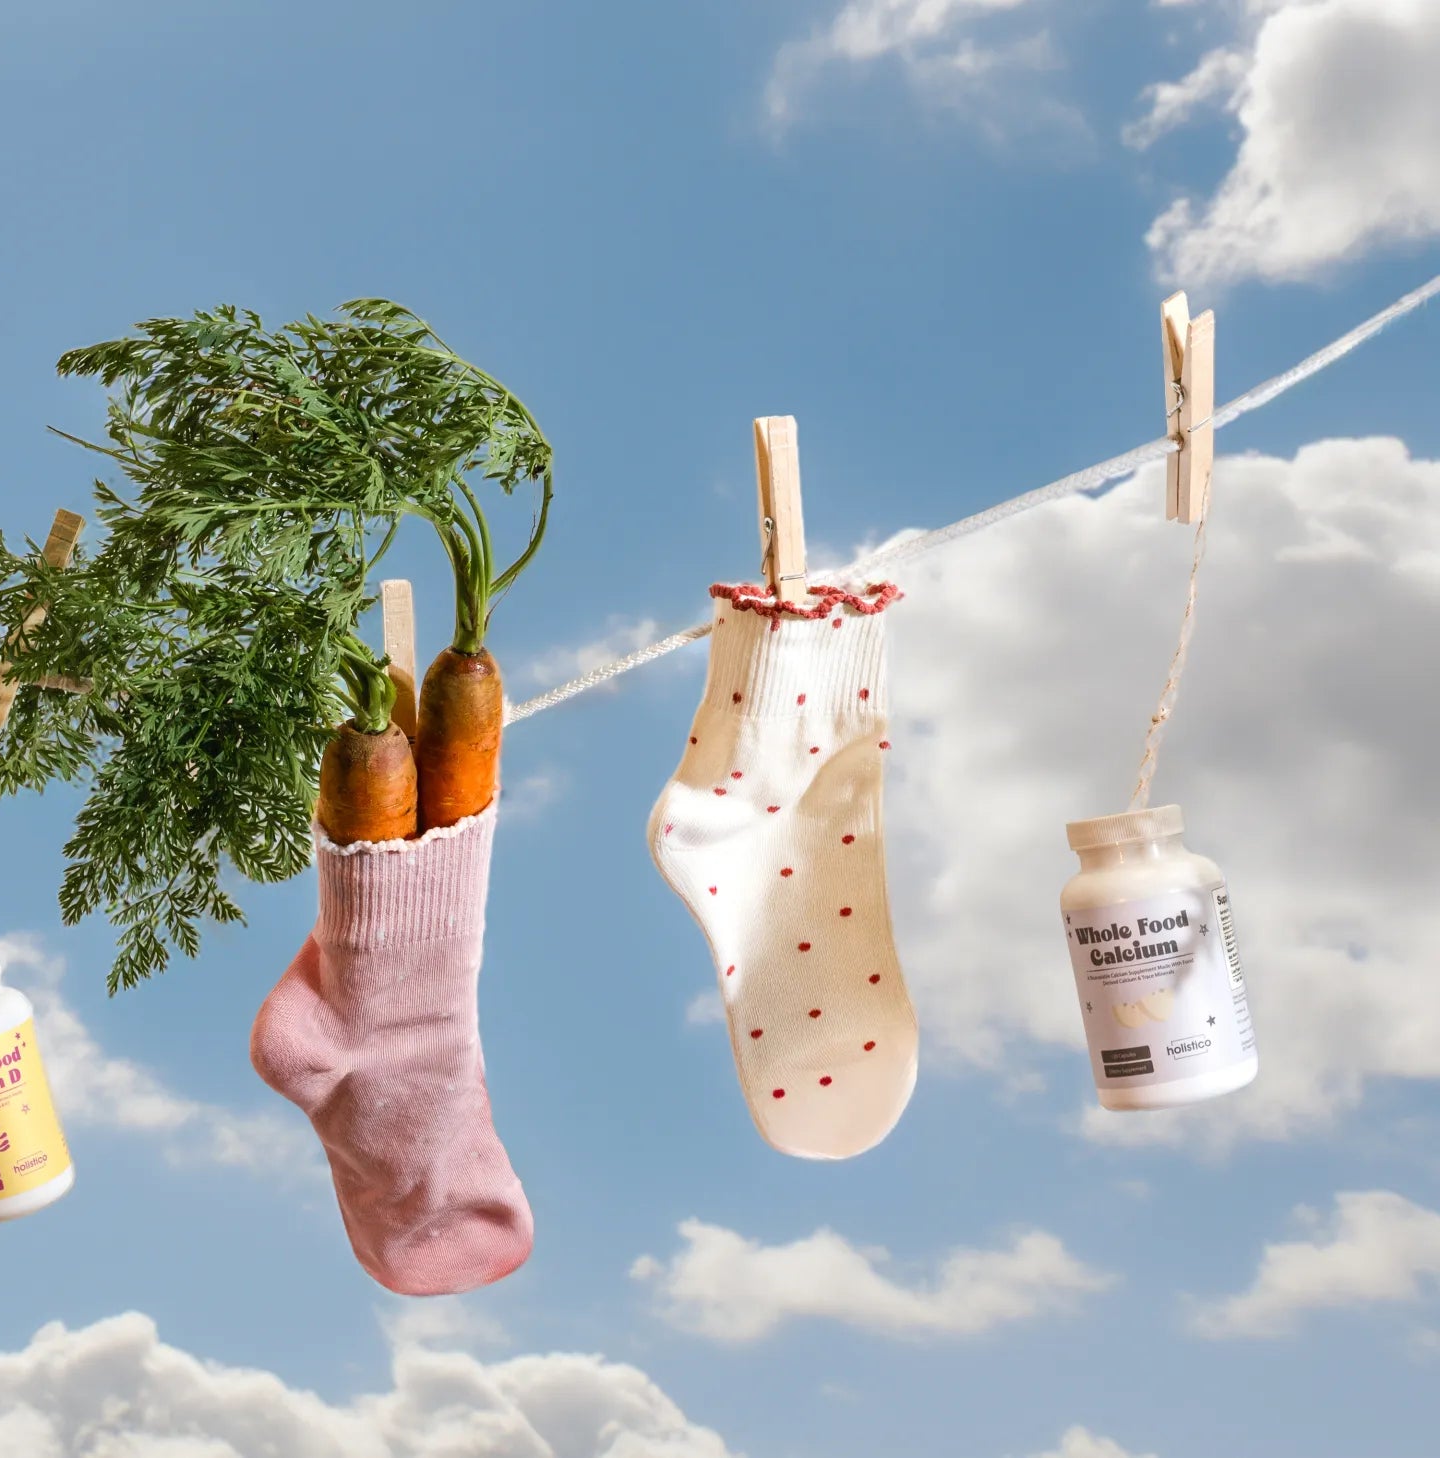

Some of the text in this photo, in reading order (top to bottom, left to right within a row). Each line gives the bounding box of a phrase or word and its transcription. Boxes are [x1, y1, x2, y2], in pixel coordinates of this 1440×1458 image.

[1075, 910, 1189, 946] Whole Food
[1090, 940, 1178, 966] Calcium
[1166, 1038, 1212, 1056] holistico
[8, 1068, 22, 1084] D
[14, 1154, 48, 1174] holistico
